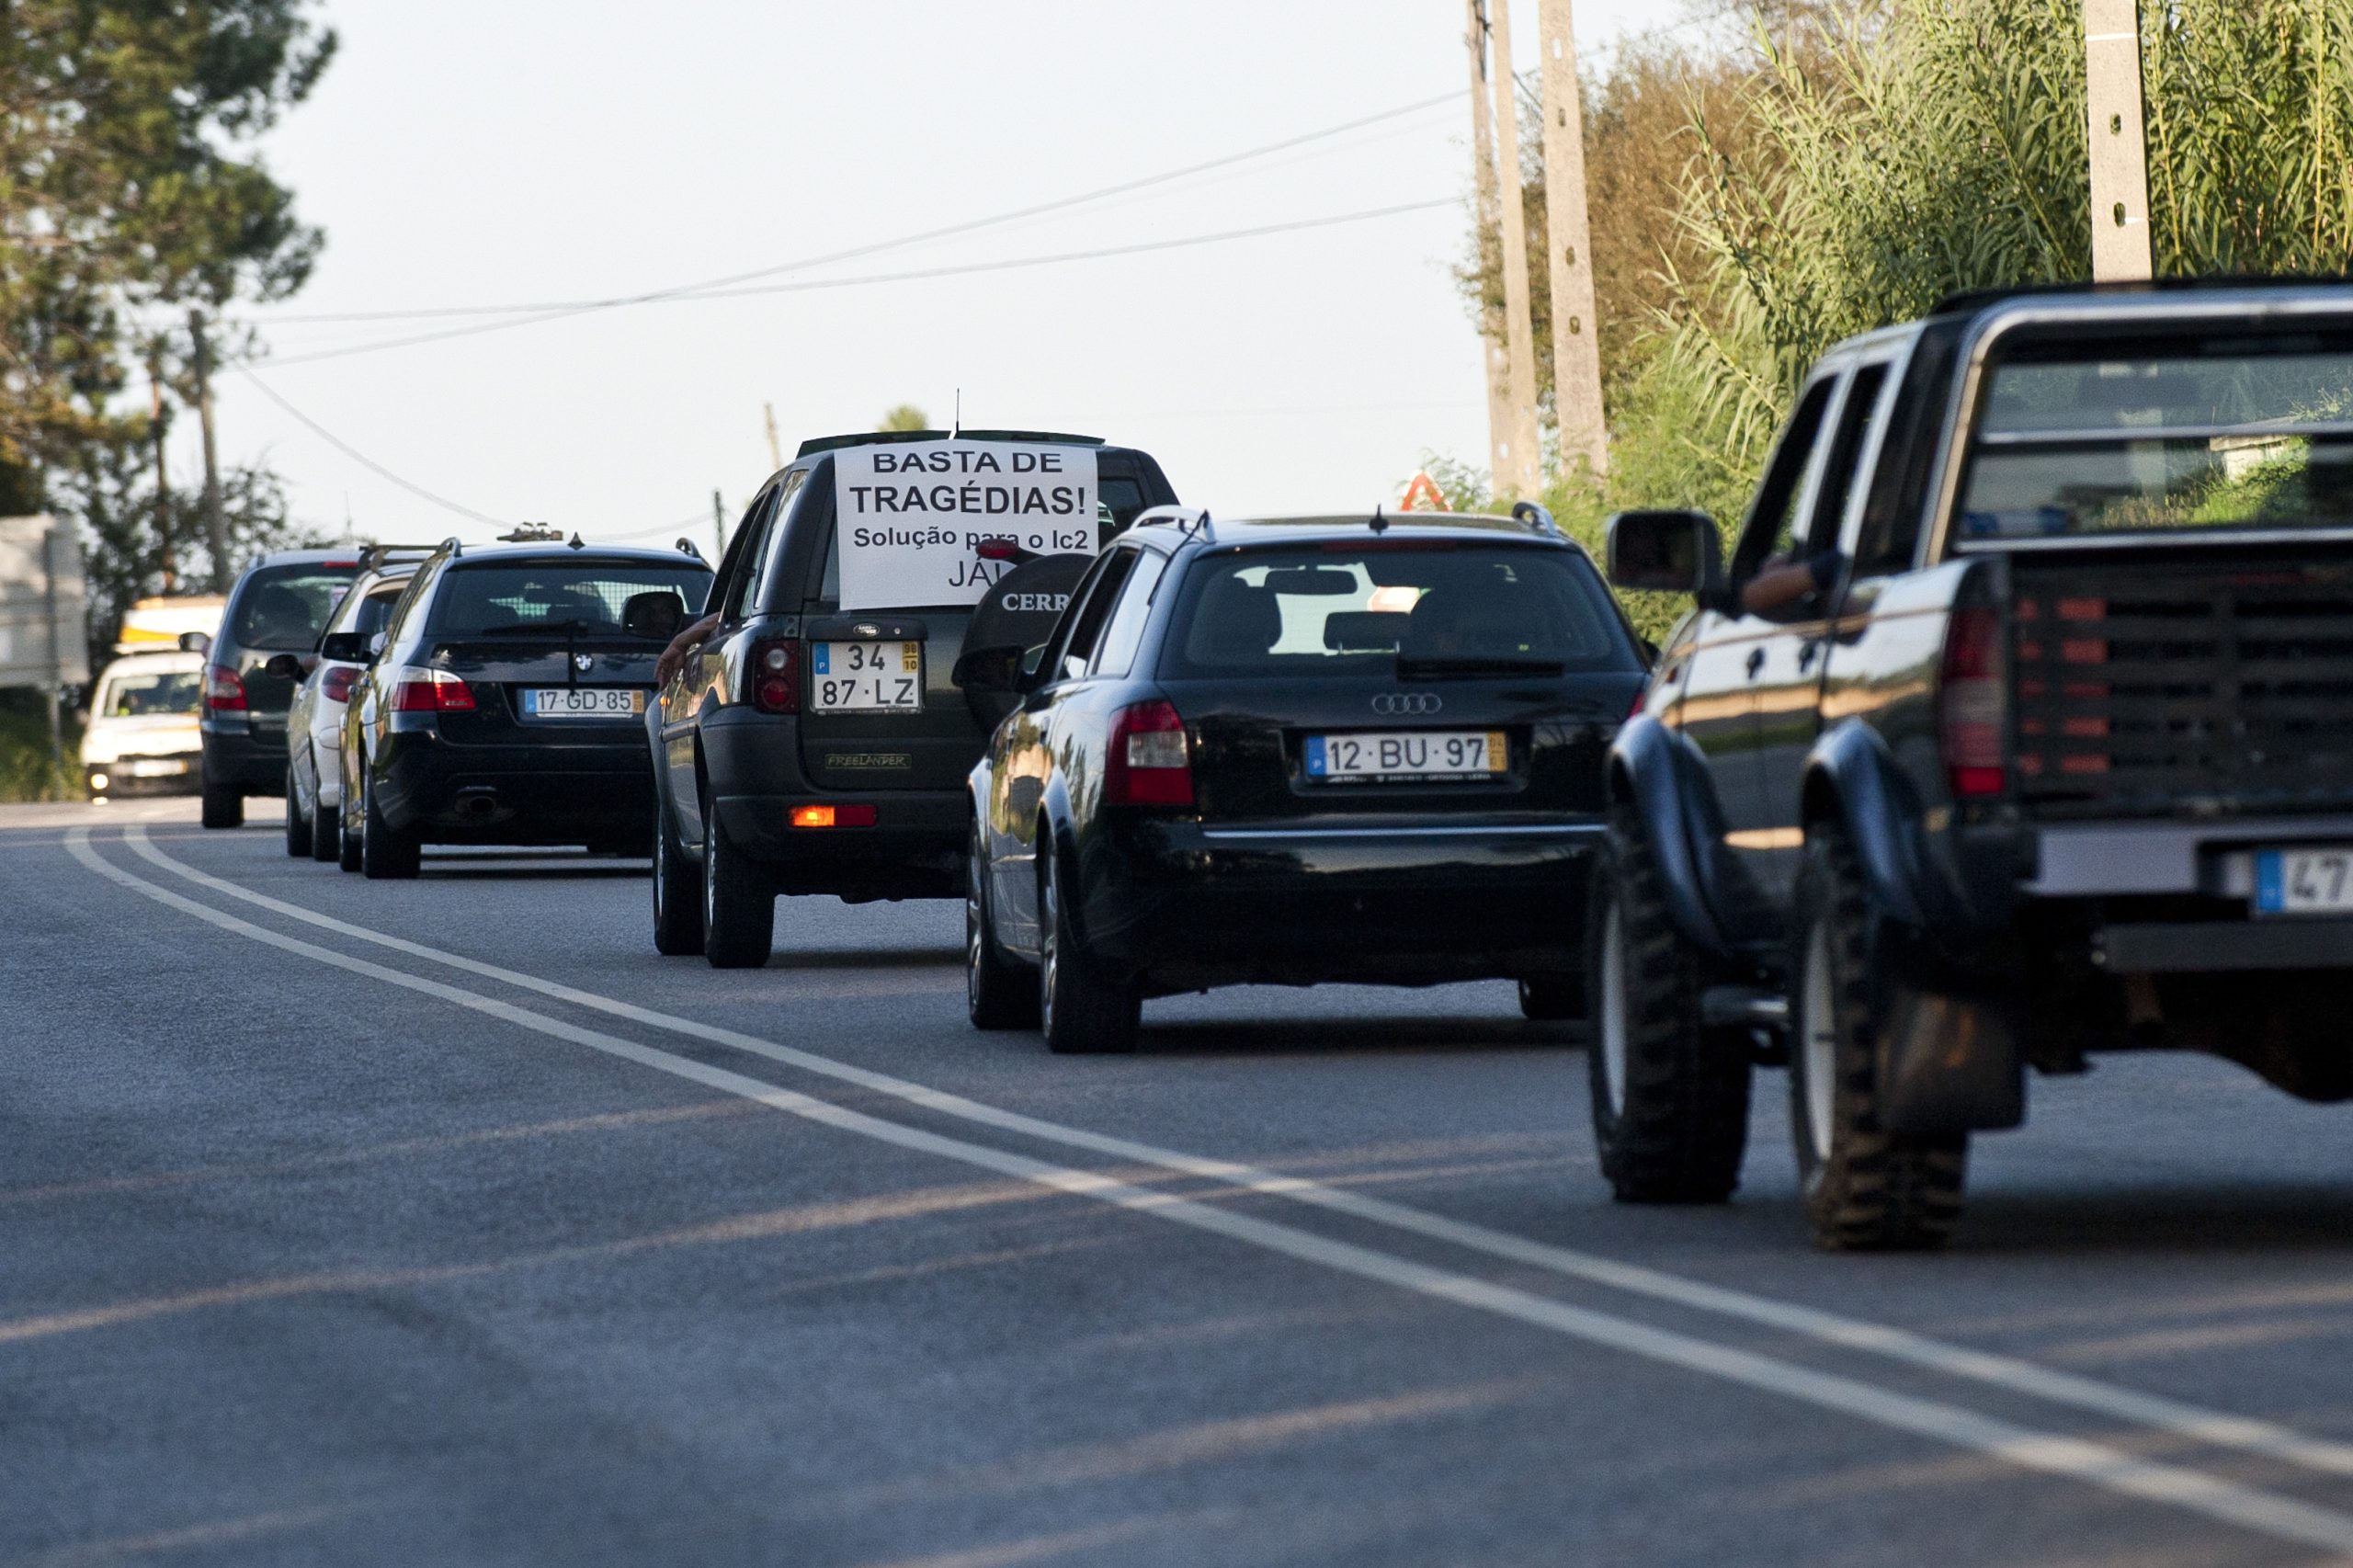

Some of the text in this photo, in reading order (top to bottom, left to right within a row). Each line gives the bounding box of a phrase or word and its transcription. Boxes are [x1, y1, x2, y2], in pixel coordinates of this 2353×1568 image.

[873, 450, 1063, 473] BASTA DE
[849, 480, 1085, 515] TRAGÉDIAS!
[854, 526, 957, 550] Solução
[1029, 534, 1043, 549] o
[847, 645, 885, 671] 34
[904, 660, 917, 670] 10
